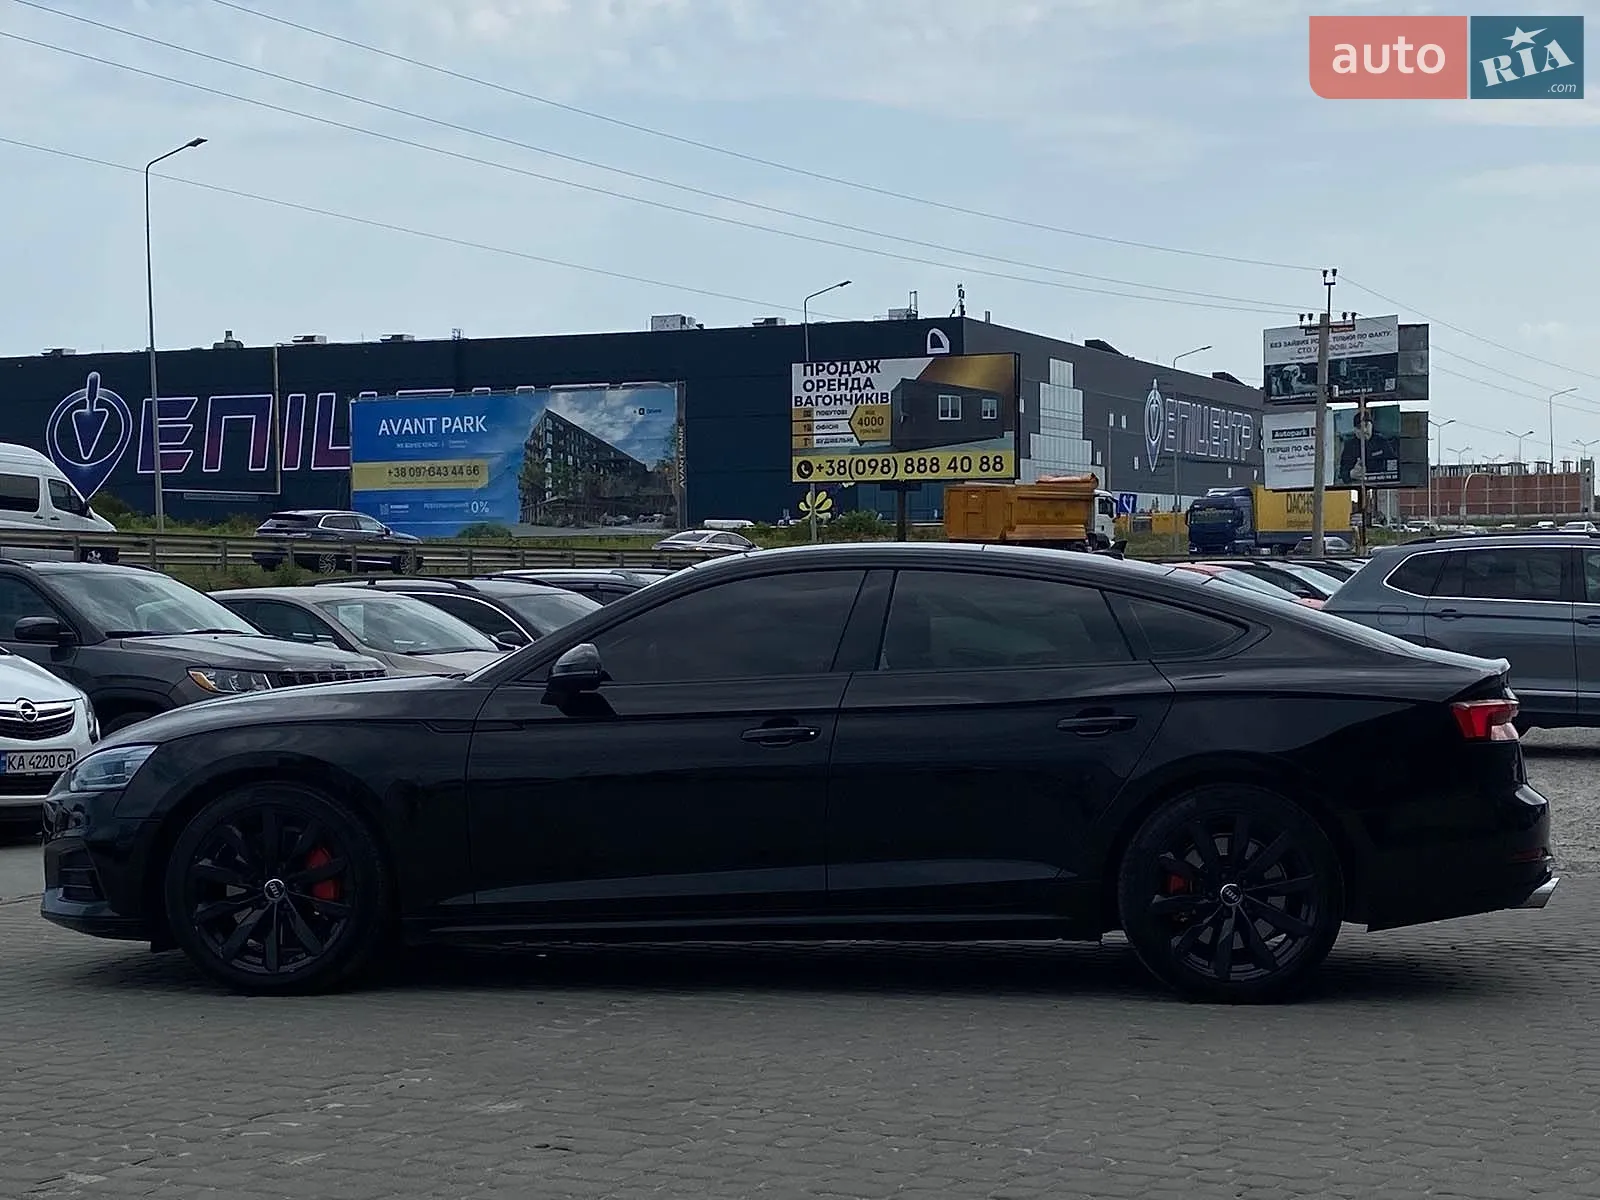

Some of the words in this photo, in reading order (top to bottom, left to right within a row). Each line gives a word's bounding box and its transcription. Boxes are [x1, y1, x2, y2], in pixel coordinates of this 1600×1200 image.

[803, 360, 881, 377] ПРОДАЖ
[803, 377, 875, 393] ОРЕНДА
[794, 392, 890, 408] ВАГОНЧИКІВ
[378, 417, 438, 436] AVANT
[441, 415, 488, 434] PARK
[857, 416, 884, 427] 4000
[387, 467, 407, 478] +38
[408, 466, 426, 478] 097
[451, 465, 464, 477] 44
[816, 455, 899, 479] +38(098)
[904, 456, 941, 475] 888
[947, 455, 972, 473] 40
[979, 454, 1004, 473] 88
[471, 500, 490, 513] 0%
[8, 754, 26, 770] KA
[29, 754, 56, 769] 4220
[57, 753, 73, 768] CA
